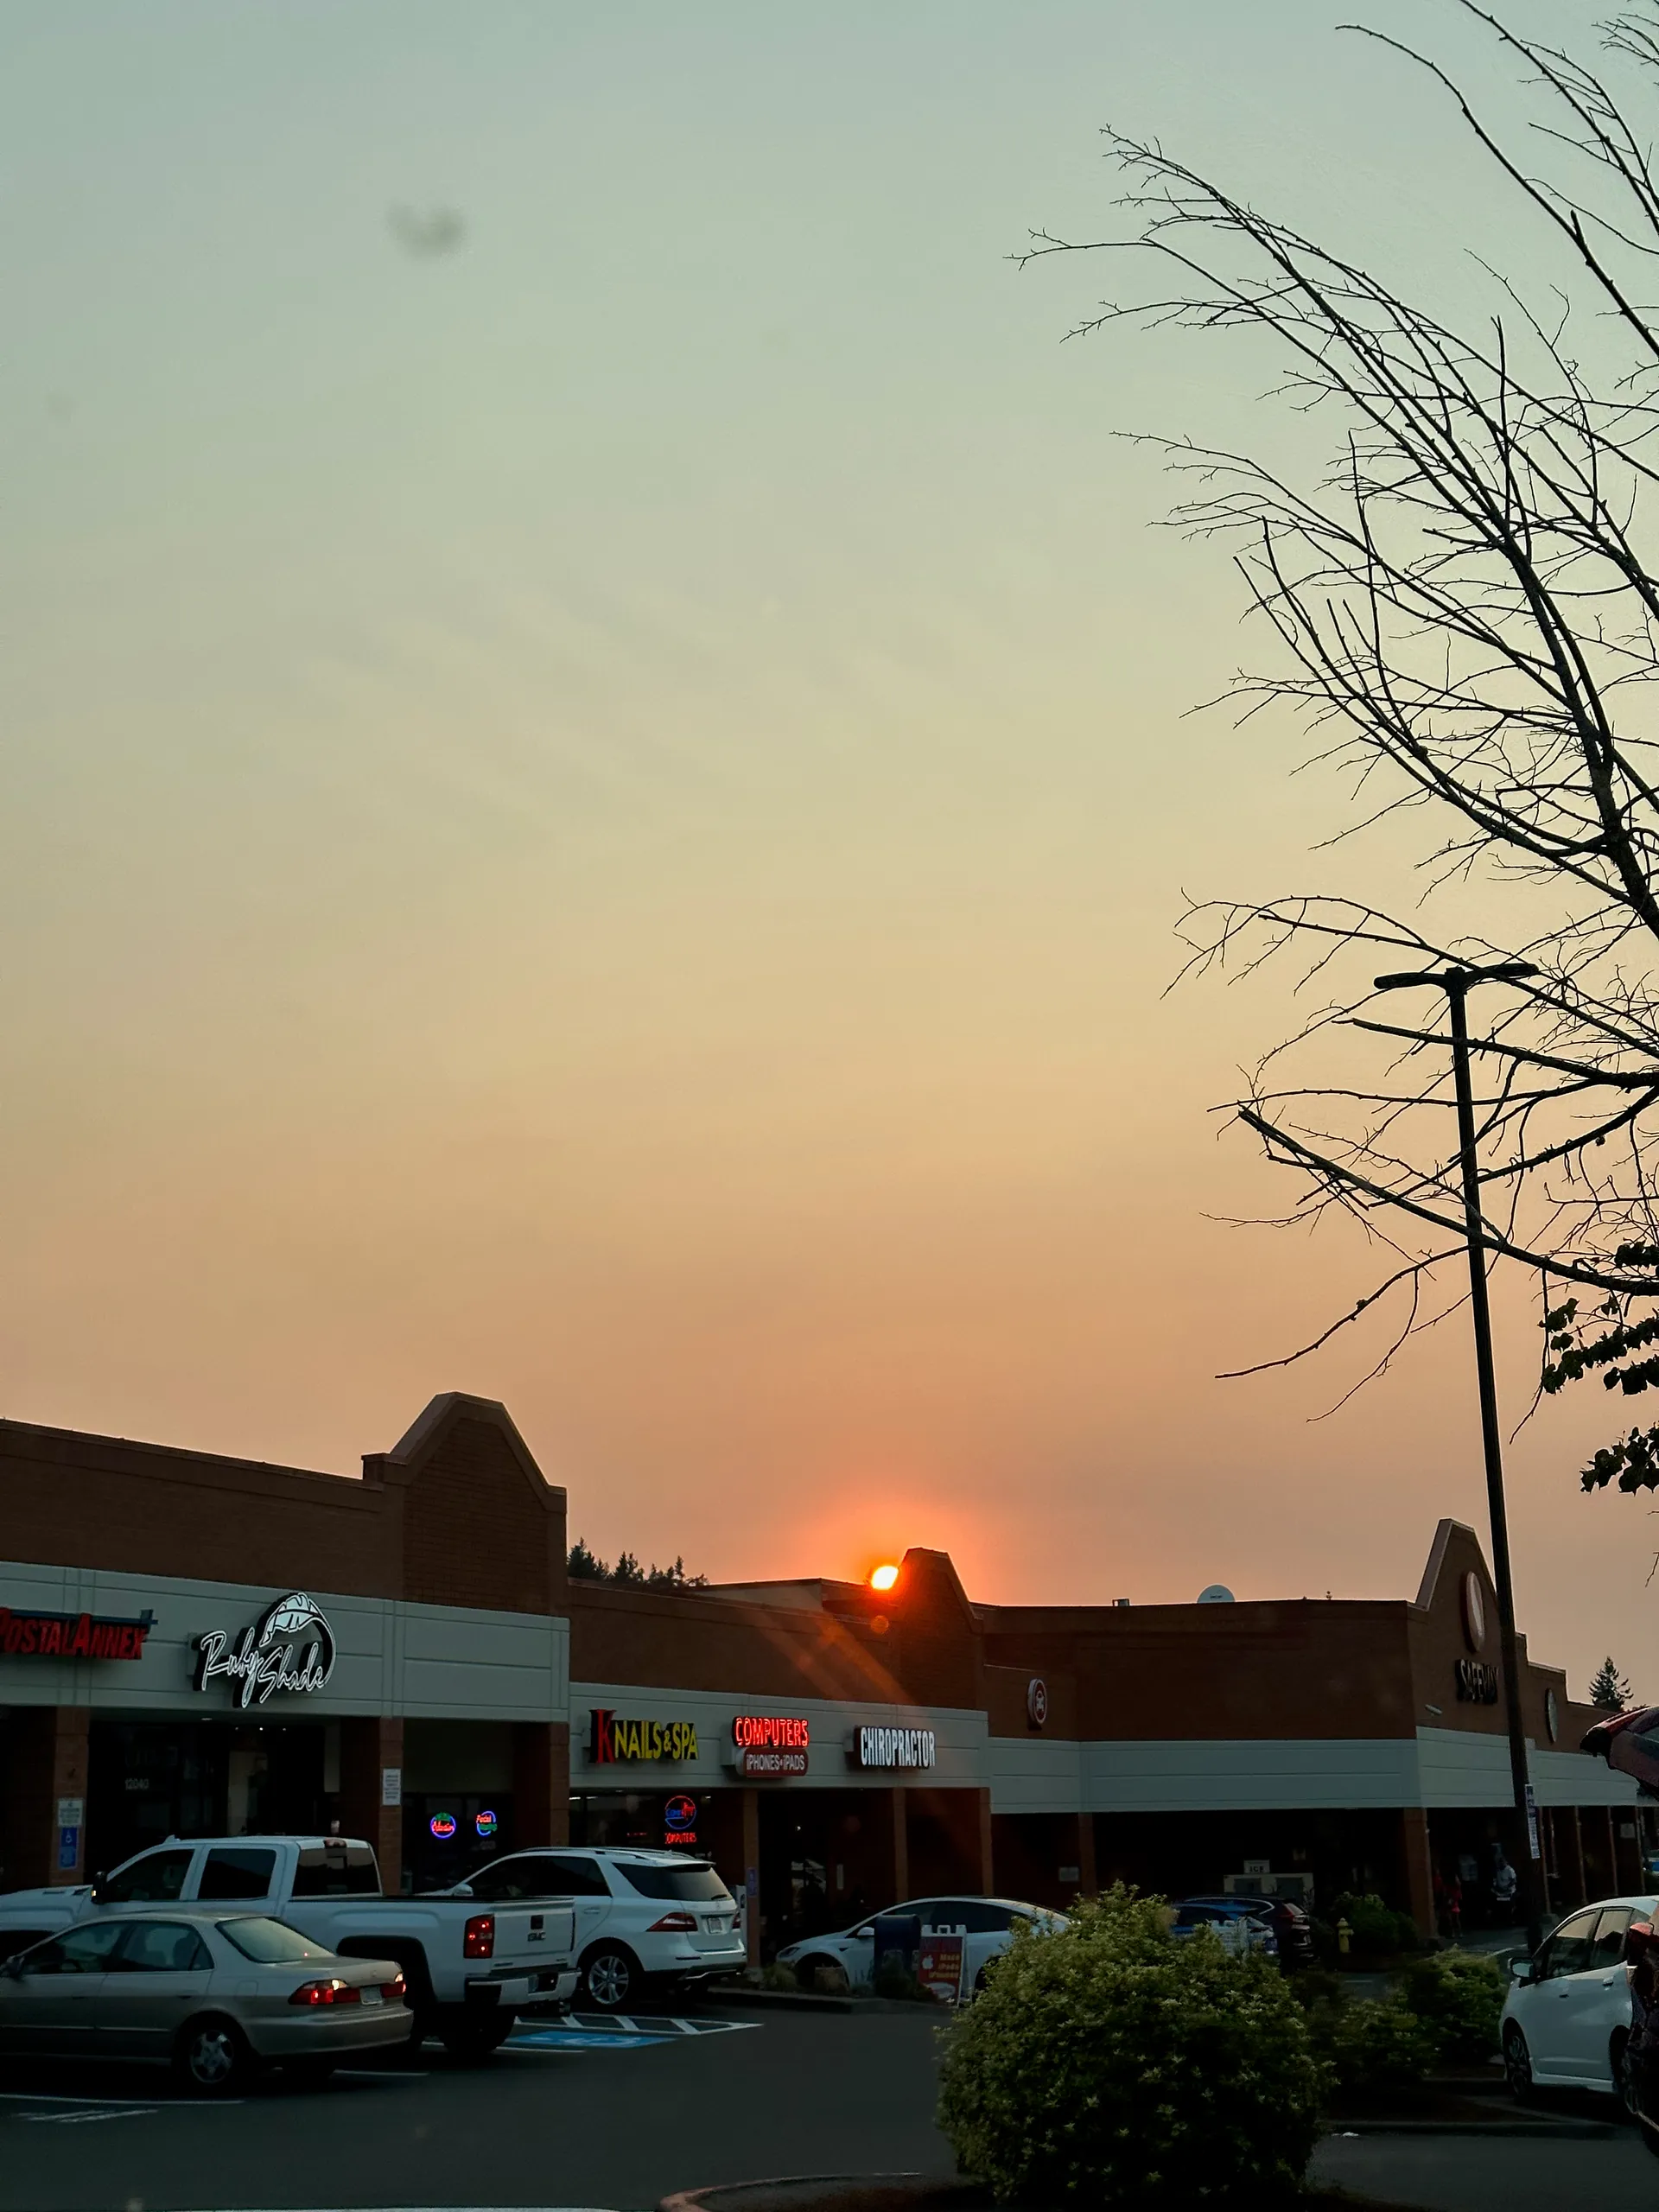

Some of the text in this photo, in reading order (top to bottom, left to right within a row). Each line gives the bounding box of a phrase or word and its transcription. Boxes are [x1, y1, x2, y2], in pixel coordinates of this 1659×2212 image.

[200, 1626, 326, 1708] Ruby Shade
[596, 1708, 617, 1764] K
[734, 1717, 809, 1747] COMPUTERS
[860, 1726, 936, 1767] CHIROPRACTOR
